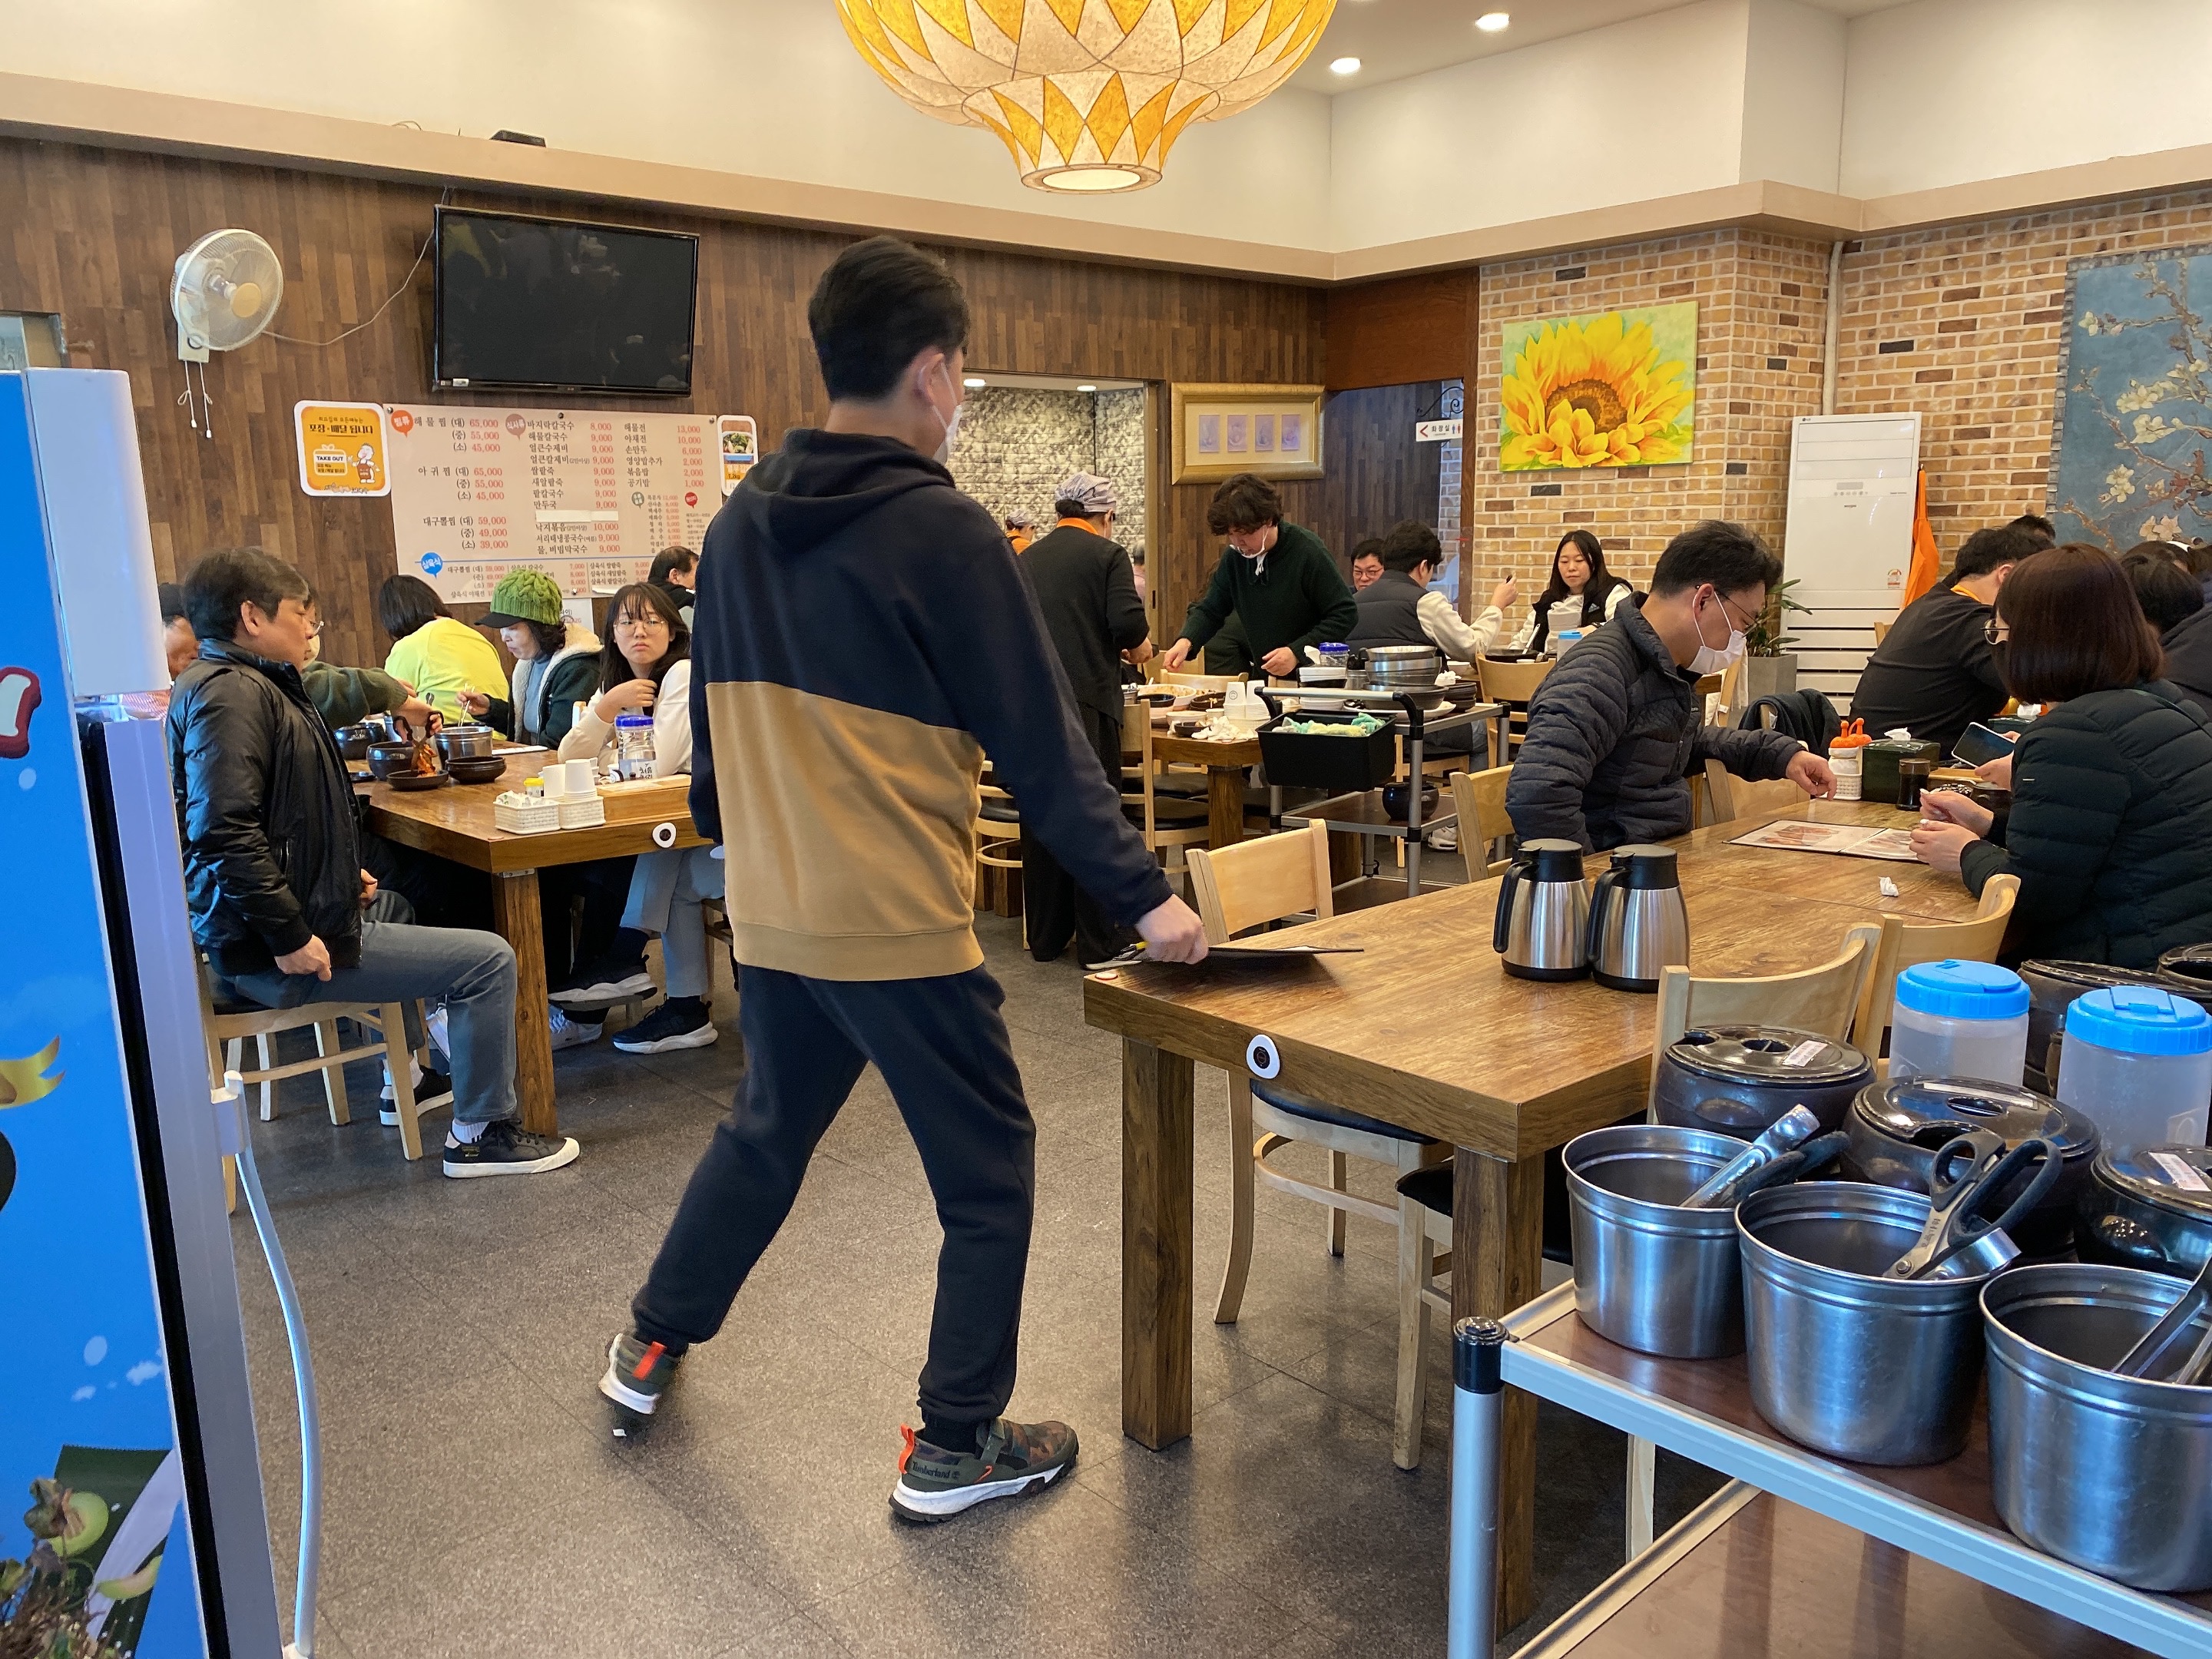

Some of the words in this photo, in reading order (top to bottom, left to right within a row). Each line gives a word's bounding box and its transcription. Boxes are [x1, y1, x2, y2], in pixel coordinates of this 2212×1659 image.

[451, 417, 465, 428] (대)
[470, 419, 498, 428] 65,000
[527, 420, 575, 430] 바지락칼국수
[591, 422, 611, 431] 8,000
[624, 423, 646, 432] 해물전
[677, 426, 700, 434] 13,000
[452, 430, 465, 440] (중)
[471, 432, 499, 441] 55,000
[528, 432, 568, 442] 해물칼국수
[591, 434, 612, 442] 9,000
[624, 434, 647, 443] 야채전
[678, 436, 701, 445] 10,000
[453, 442, 467, 452] (소)
[472, 444, 501, 453] 45,000
[529, 443, 568, 453] 얼큰수제비
[625, 445, 647, 455] 손만두
[592, 456, 614, 465] 9,000
[626, 456, 663, 466] 영양밥추가
[683, 458, 703, 466] 2,000
[455, 467, 469, 476] (대)
[474, 468, 502, 477] 65,000
[531, 466, 555, 475] 쌀팥죽
[627, 468, 649, 477] 볶음밥
[684, 469, 704, 477] 2,000
[456, 478, 470, 488] (중)
[475, 480, 503, 488] 55,000
[531, 478, 563, 487] 새알팥죽
[628, 478, 650, 488] 공기밥
[685, 479, 704, 488] 1,000
[458, 491, 471, 501] (소)
[475, 492, 505, 501] 45,000
[533, 489, 564, 498] 팥칼국수
[595, 490, 617, 498] 9,000
[534, 501, 557, 510] 만두국
[460, 516, 473, 525] (대)
[478, 517, 506, 525] 59,000
[594, 523, 619, 532] 10,000
[461, 528, 474, 538] (중)
[479, 528, 507, 538] 49,000
[598, 534, 620, 542] 9,000
[462, 540, 475, 550] (소)
[480, 541, 508, 549] 39,000
[549, 545, 588, 554] 비빔막국수
[599, 545, 621, 553] 9,000
[912, 1461, 951, 1479] Timberland
